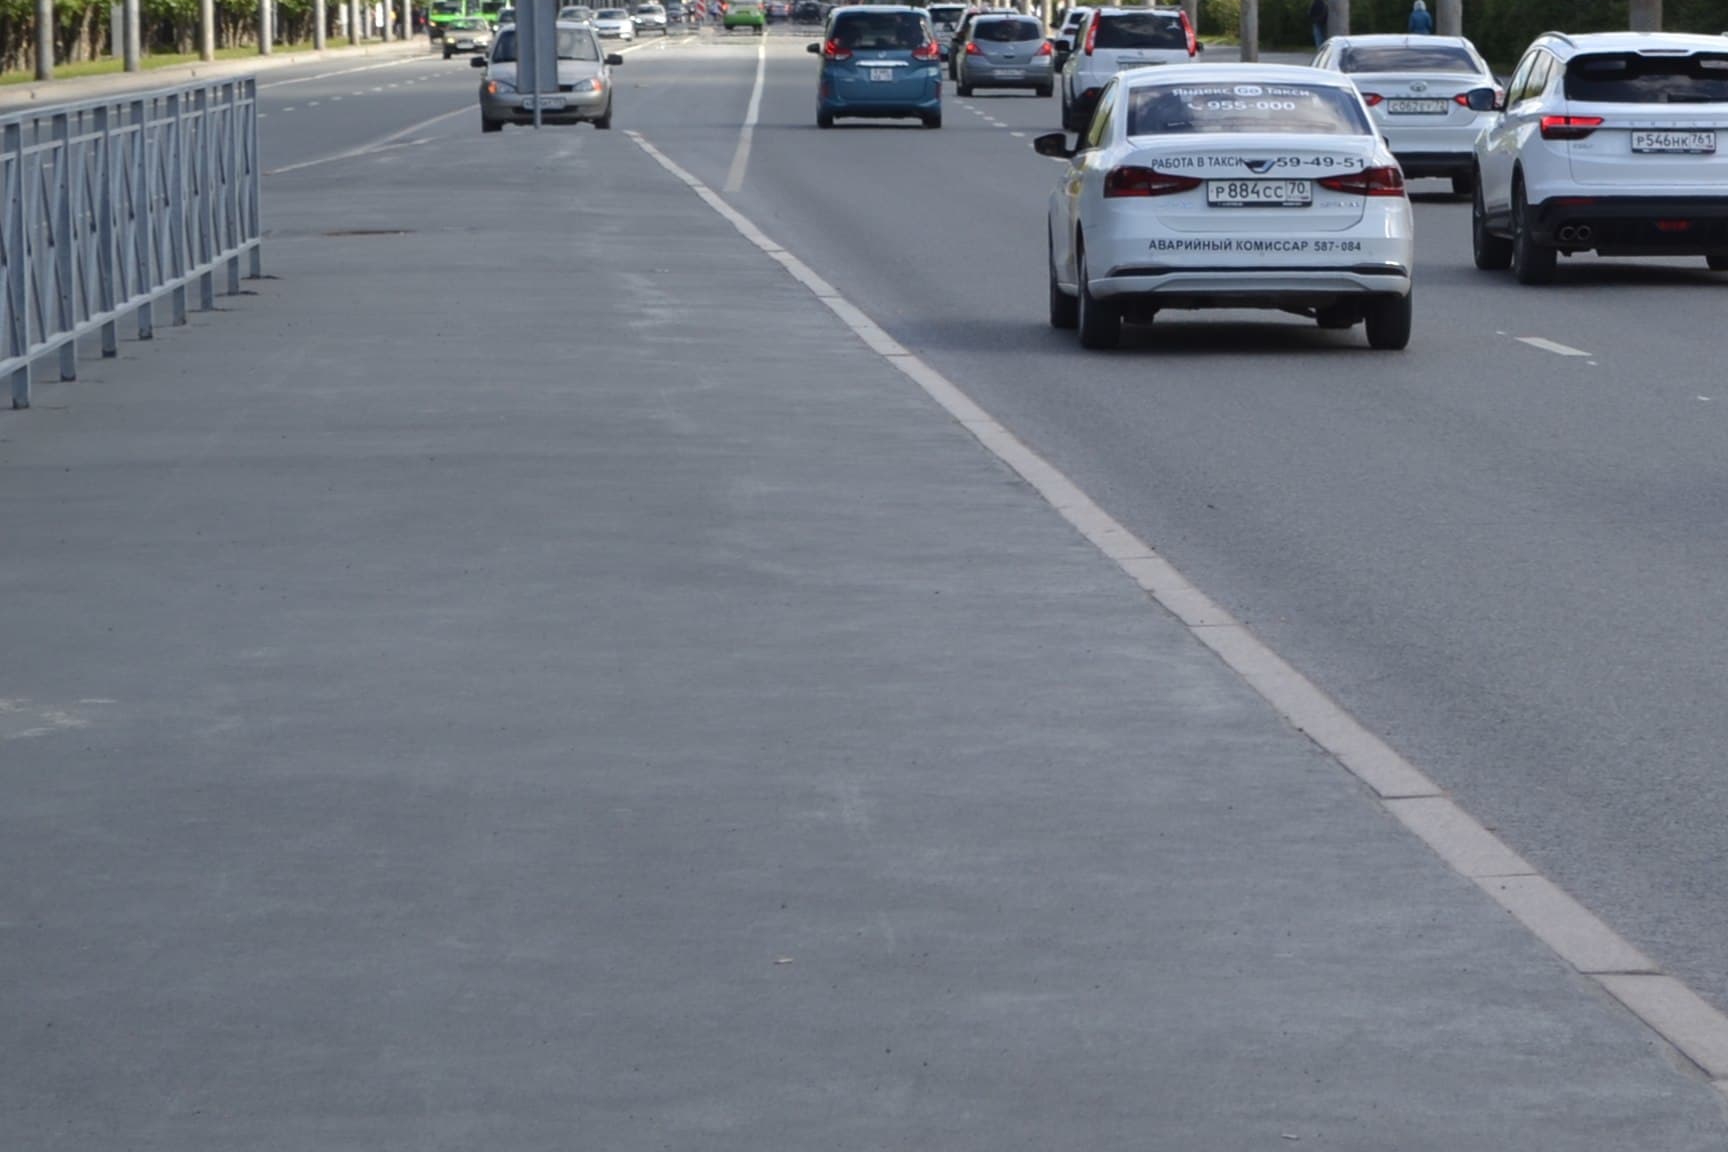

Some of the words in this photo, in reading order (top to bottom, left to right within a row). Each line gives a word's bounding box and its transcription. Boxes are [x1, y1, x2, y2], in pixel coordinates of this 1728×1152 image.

[1266, 87, 1310, 97] Такси
[1207, 100, 1296, 111] 955-000
[1151, 158, 1194, 169] РАБОТА
[1196, 157, 1205, 168] В
[1207, 156, 1244, 167] ТАКСИ
[1276, 156, 1365, 169] 59-49-51
[1215, 182, 1284, 198] Р884СС
[1148, 238, 1233, 251] АВАРИЙНЫЙ
[1236, 240, 1309, 252] КОМИССАР
[1314, 241, 1362, 252] 587-084
